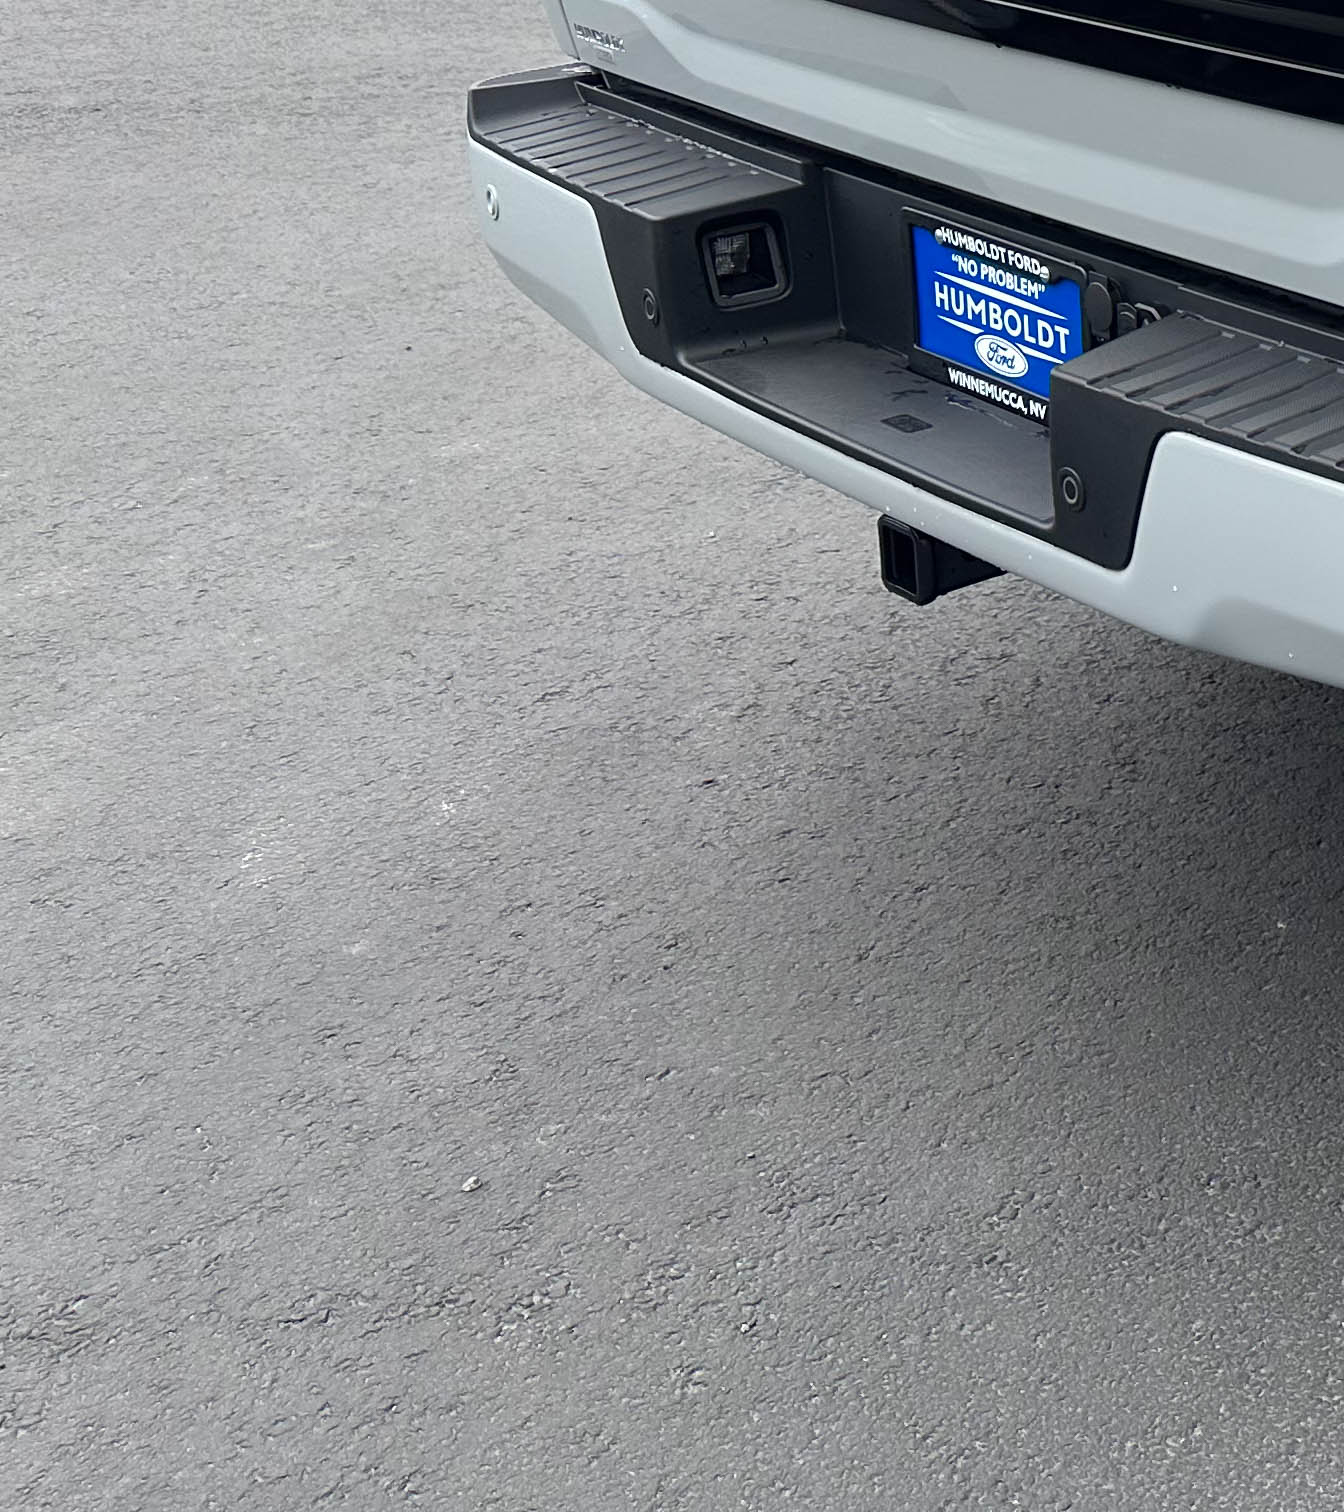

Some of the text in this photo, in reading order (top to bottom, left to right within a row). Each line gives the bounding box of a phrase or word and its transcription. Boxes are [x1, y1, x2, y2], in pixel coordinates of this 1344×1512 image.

[941, 226, 1041, 276] HUMBOLDT FORD
[934, 281, 1070, 354] HUMBOLDT
[948, 367, 1046, 420] WINNEMUCCA, NV
